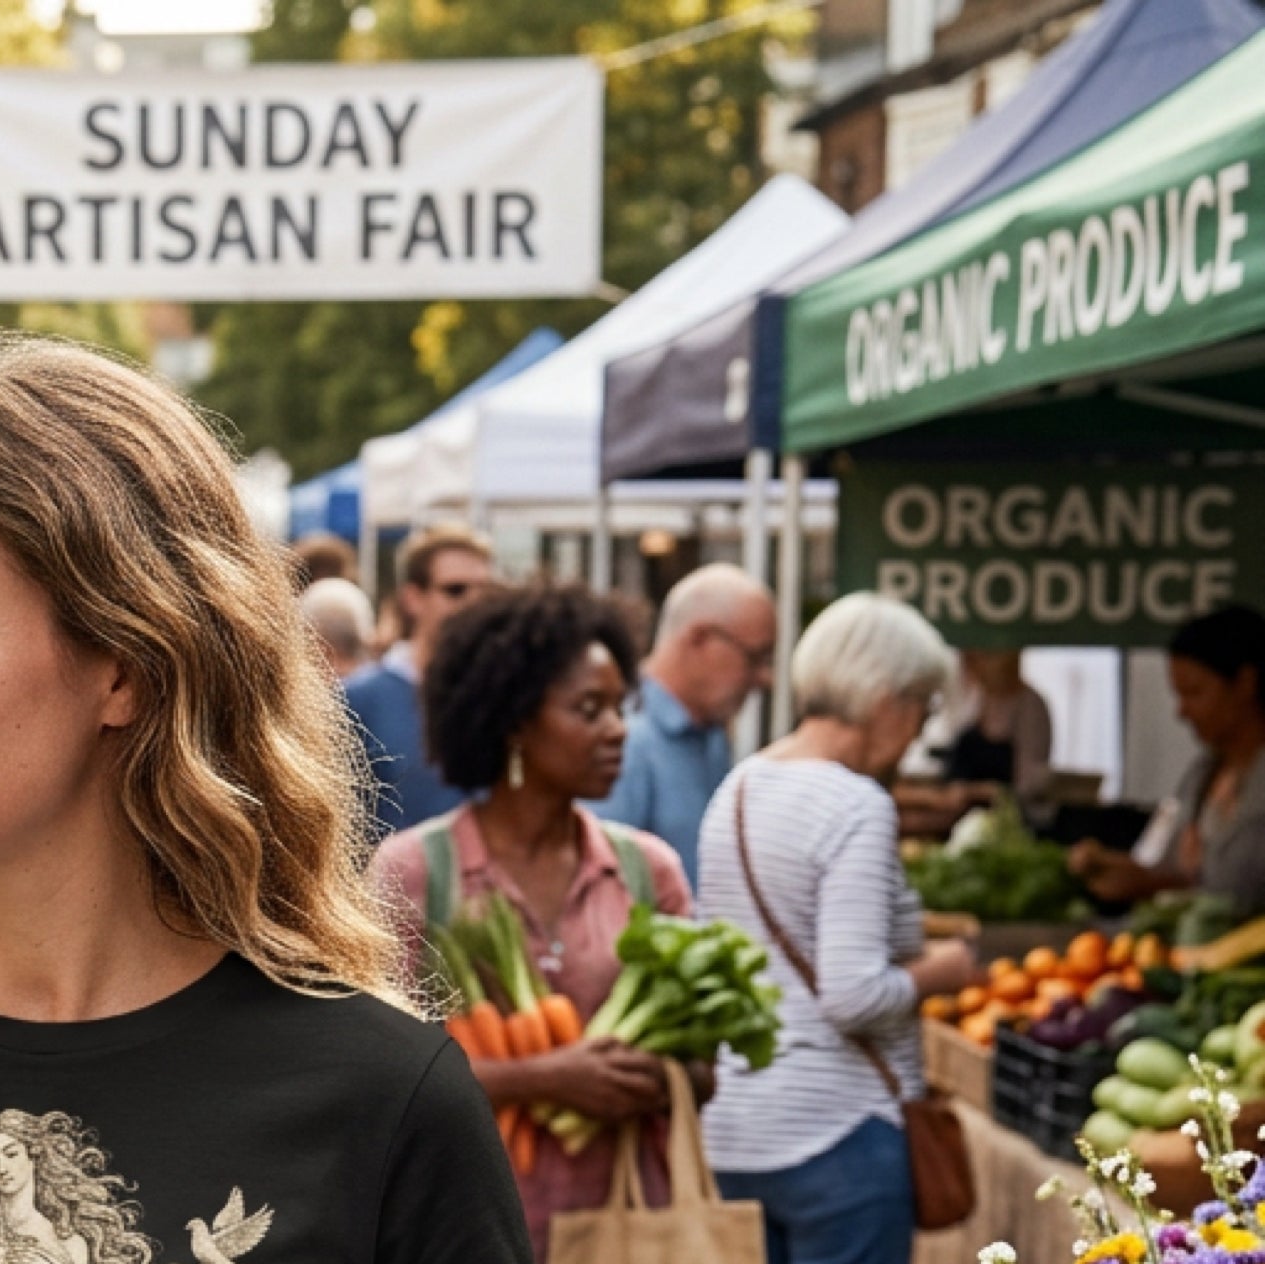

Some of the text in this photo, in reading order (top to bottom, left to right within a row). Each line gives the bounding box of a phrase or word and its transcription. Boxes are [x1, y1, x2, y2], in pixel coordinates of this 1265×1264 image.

[82, 101, 420, 172] SUNDAY
[359, 191, 538, 262] FAIR
[846, 160, 1250, 406] ORGANIC PRODUCE
[881, 483, 1234, 550] ORGANIC
